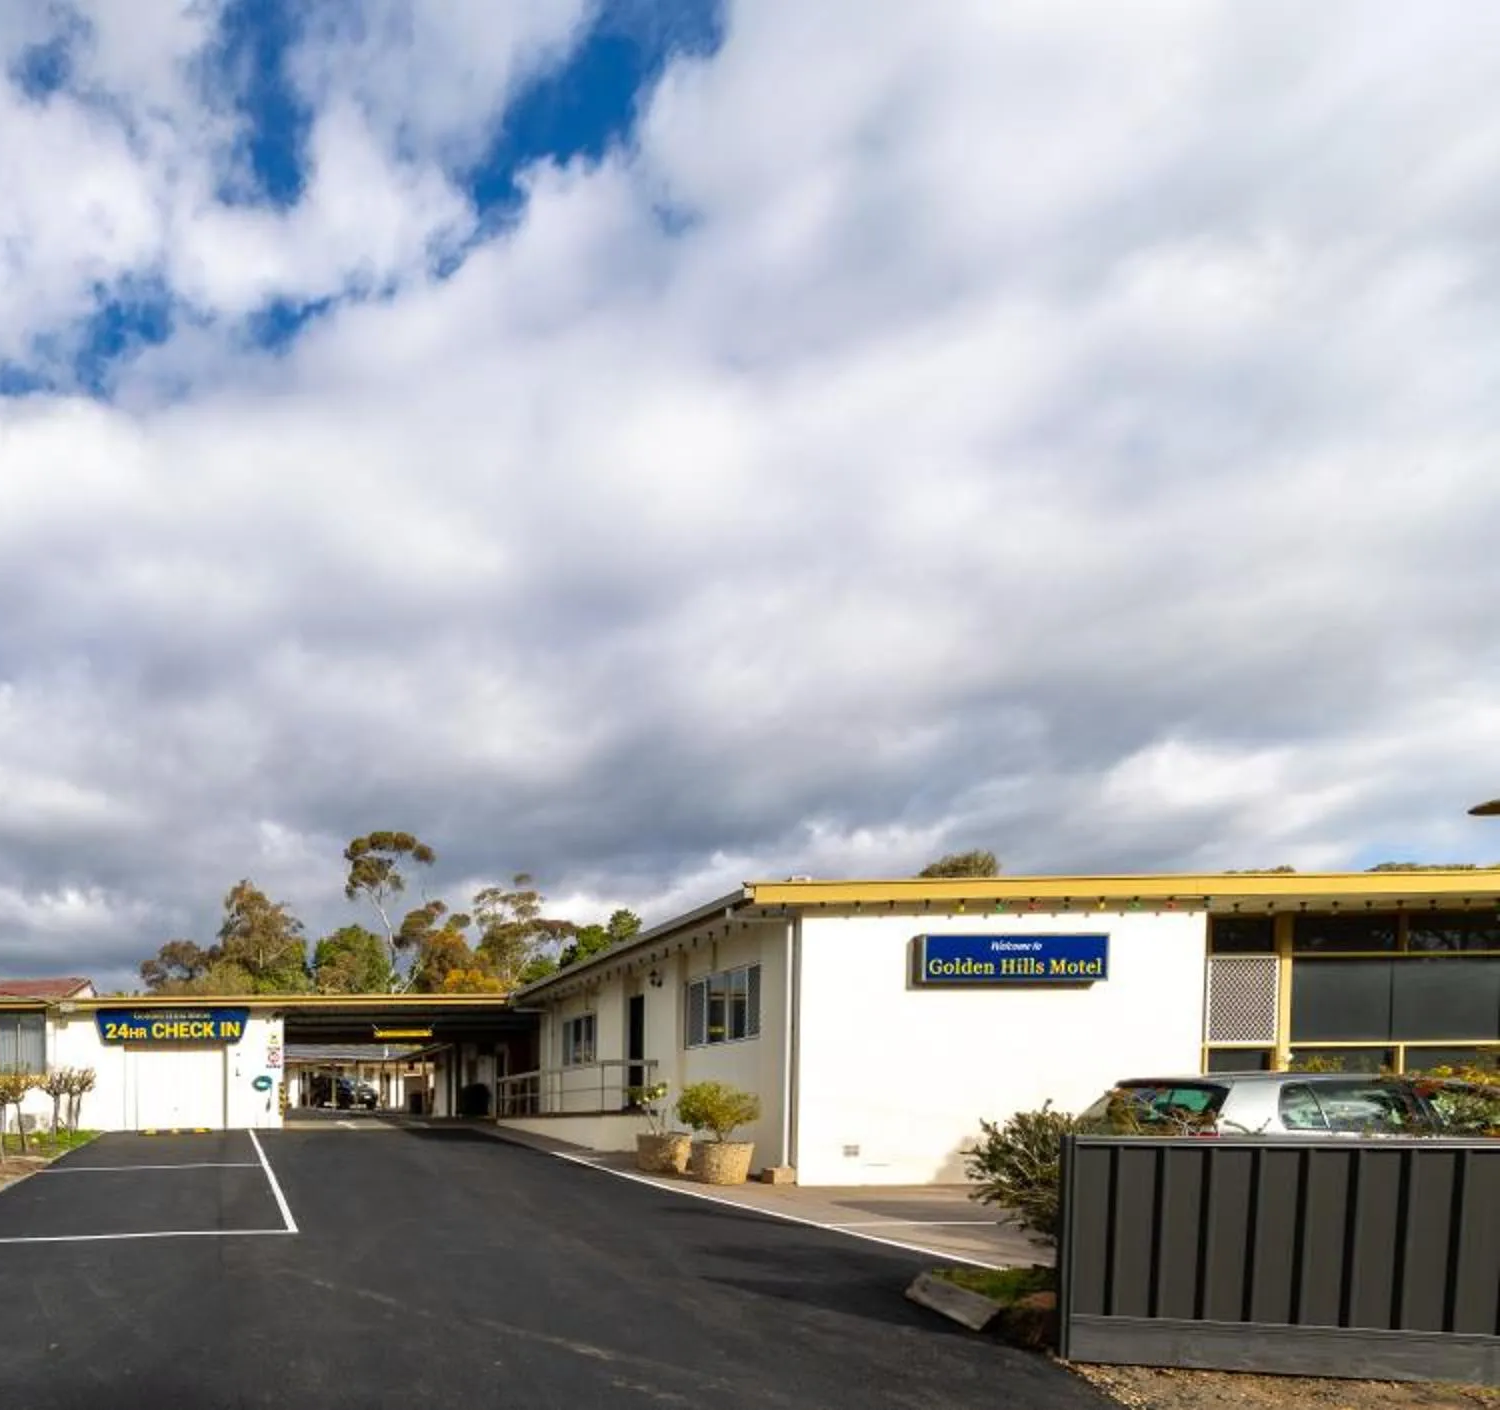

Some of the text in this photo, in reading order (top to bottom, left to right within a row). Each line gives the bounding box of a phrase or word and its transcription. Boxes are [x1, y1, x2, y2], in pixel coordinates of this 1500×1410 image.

[991, 940, 1032, 951] Welcome
[929, 957, 1102, 974] Golden Hills Motel
[152, 1021, 215, 1038] CHECK
[220, 1021, 240, 1036] IN
